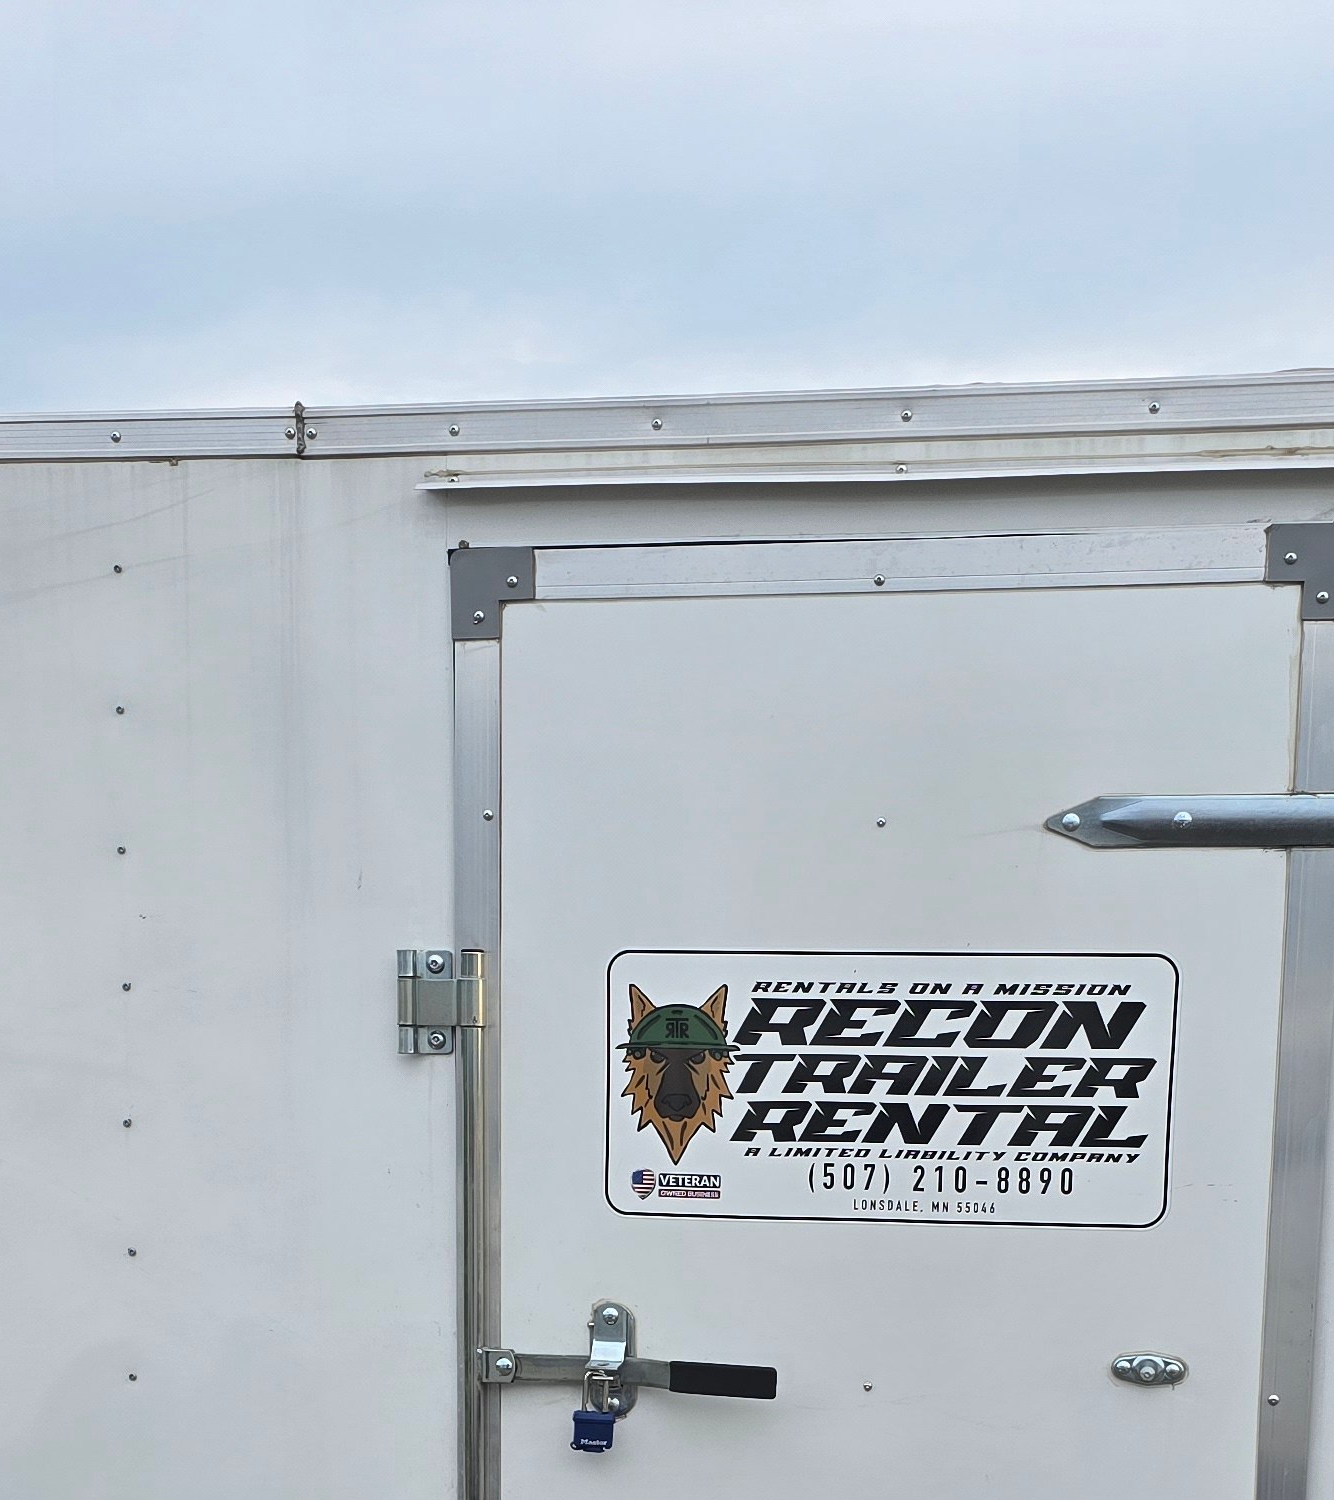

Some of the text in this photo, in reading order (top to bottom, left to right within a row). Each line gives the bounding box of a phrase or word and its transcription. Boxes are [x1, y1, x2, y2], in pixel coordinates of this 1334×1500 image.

[751, 981, 1132, 996] RENTALS ON A MISSION
[731, 997, 1147, 1049] RECON
[733, 1053, 1158, 1099] TRAILER
[729, 1100, 1149, 1149] RENTAL
[744, 1147, 1141, 1163] A LIMITED LIABILITY COMPANY
[659, 1174, 720, 1187] VETERAN
[808, 1162, 1073, 1195] (507) 210-8890
[931, 1201, 949, 1213] MN
[956, 1201, 996, 1214] 55046
[579, 1438, 608, 1446] Master
